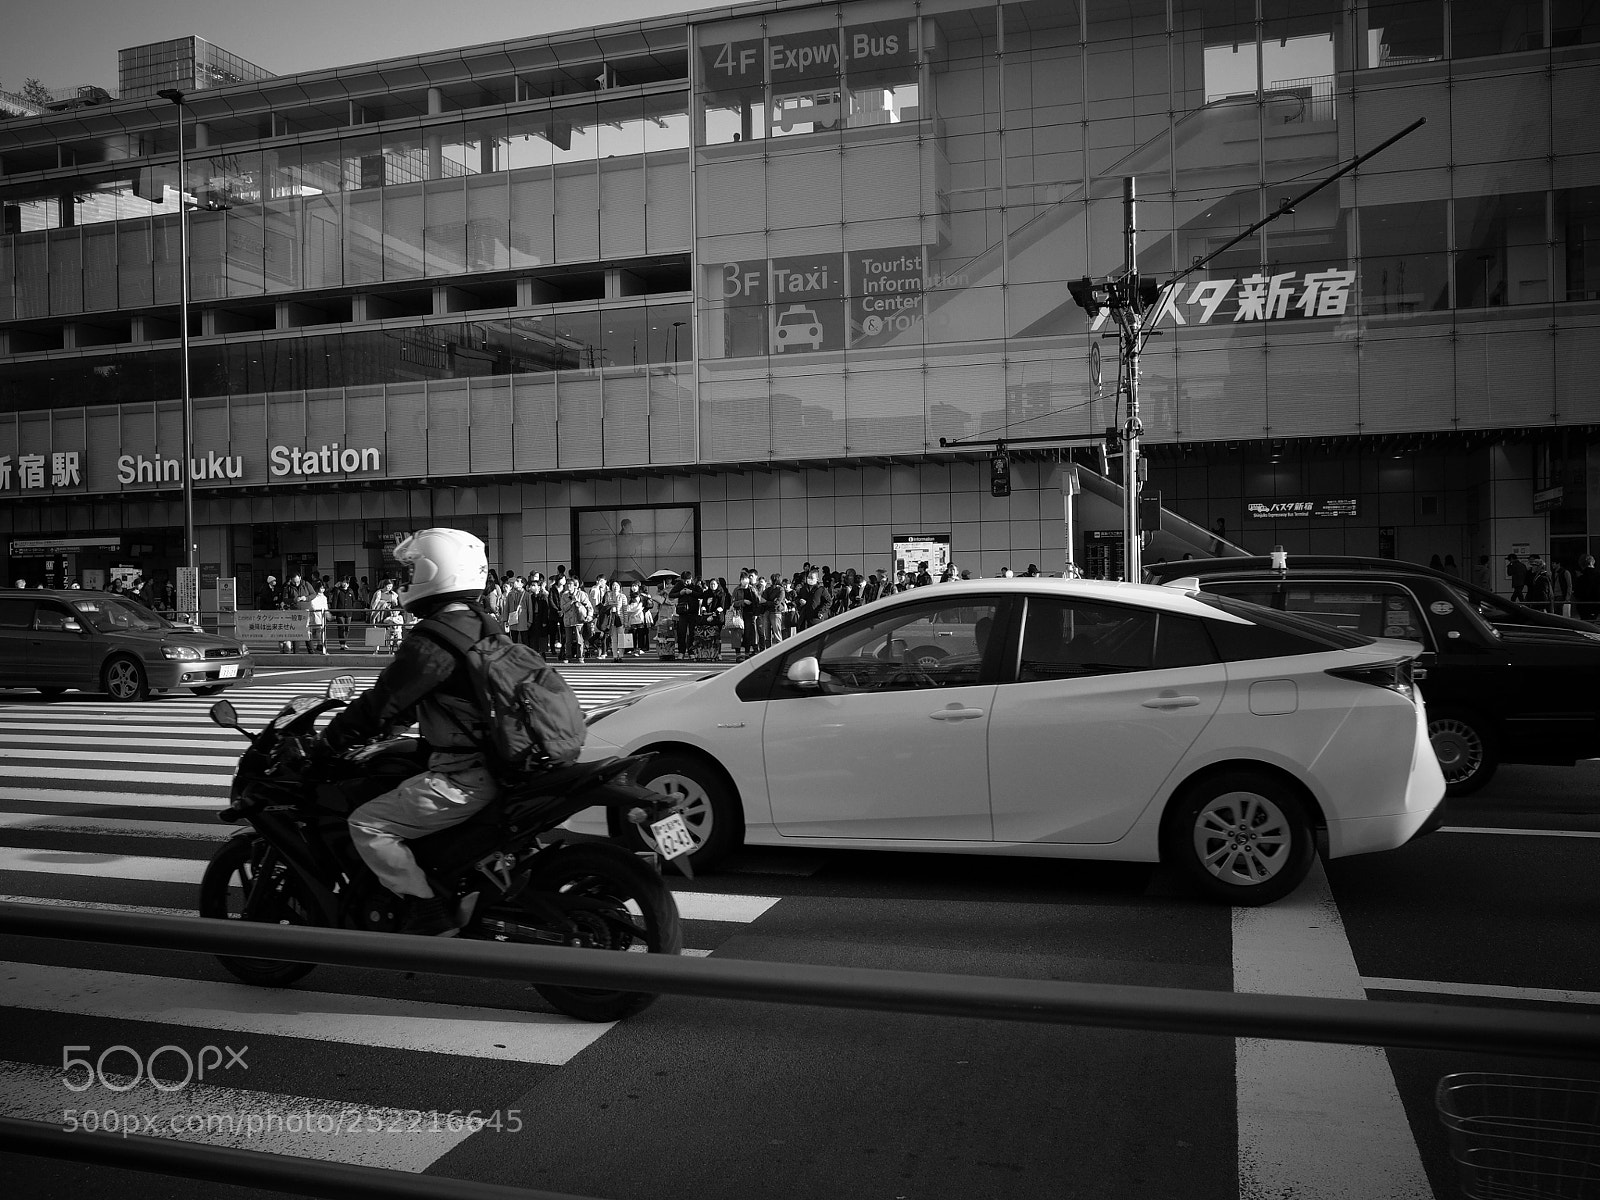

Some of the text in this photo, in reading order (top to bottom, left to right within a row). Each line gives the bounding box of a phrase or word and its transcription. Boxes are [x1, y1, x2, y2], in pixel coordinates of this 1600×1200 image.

[714, 42, 757, 76] 4F
[853, 33, 899, 59] Bus
[723, 262, 828, 298] 3F Taxi
[862, 256, 922, 275] Tourist
[862, 295, 922, 312] Center
[1091, 268, 1356, 331] スタ新宿
[117, 443, 380, 489] Shinuku Station
[1270, 502, 1313, 511] バスタ新宿
